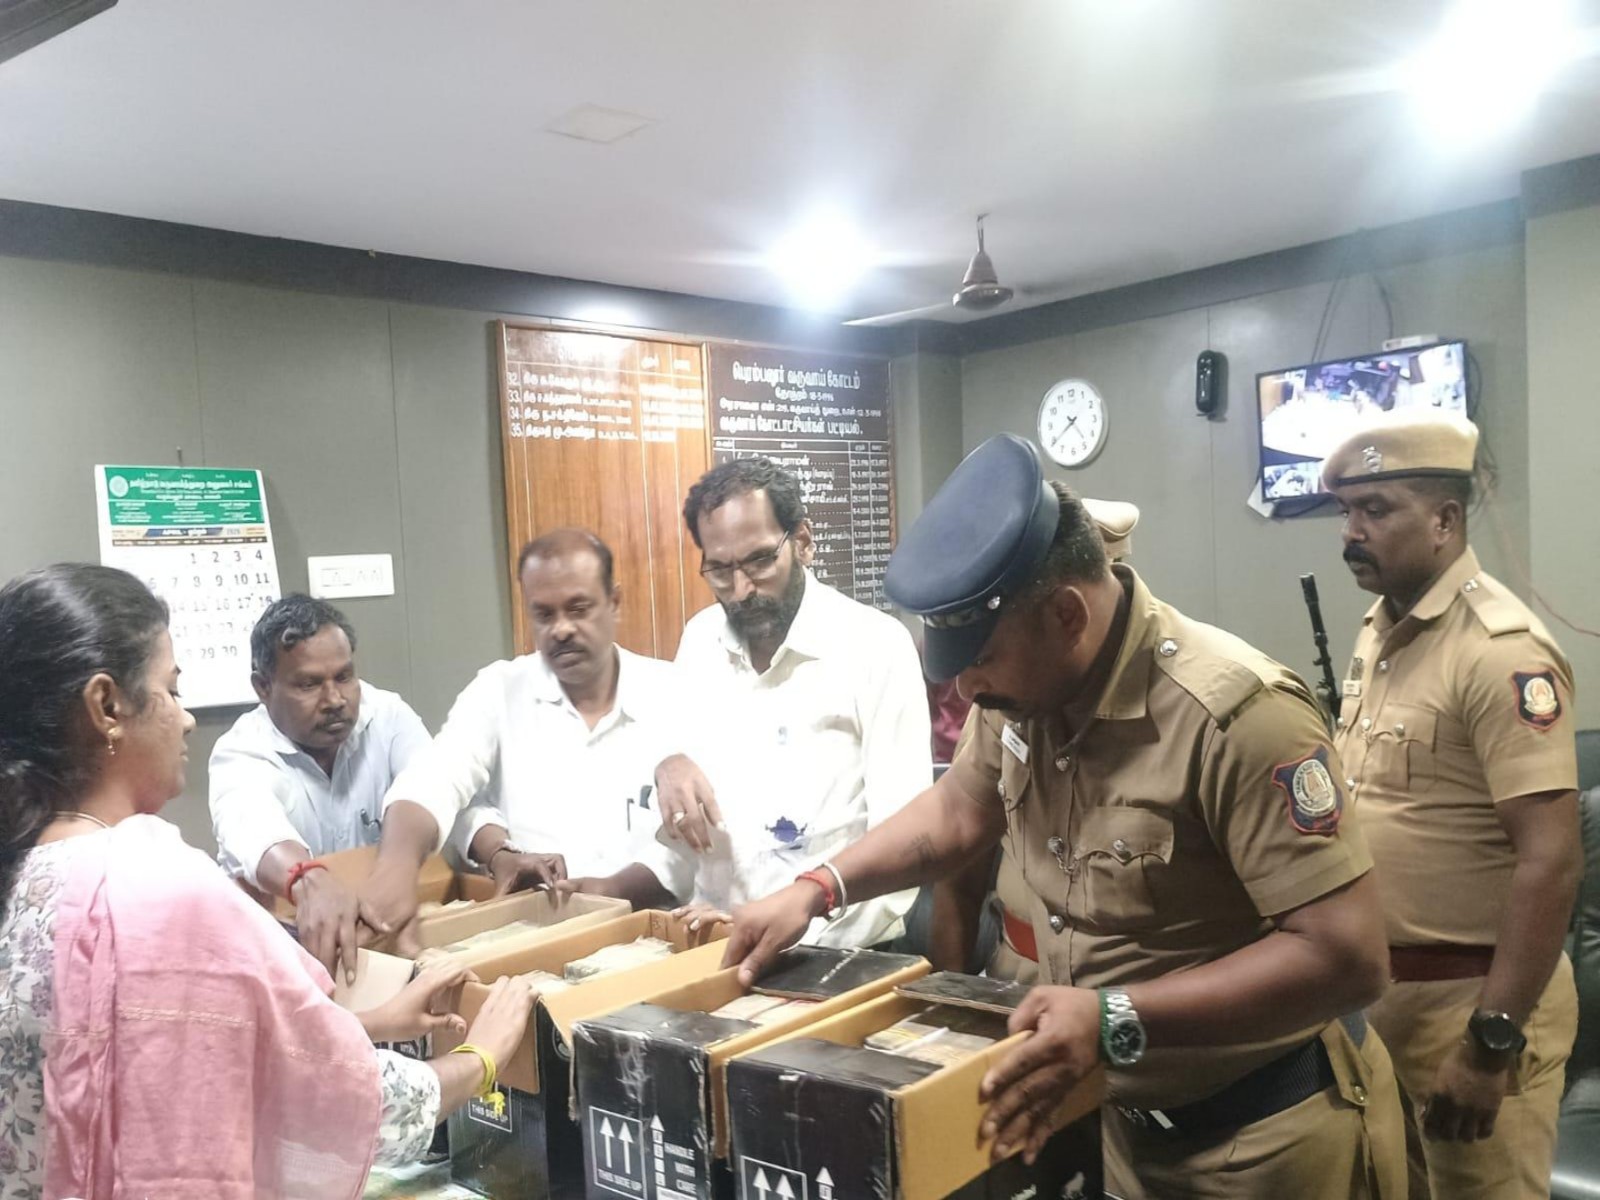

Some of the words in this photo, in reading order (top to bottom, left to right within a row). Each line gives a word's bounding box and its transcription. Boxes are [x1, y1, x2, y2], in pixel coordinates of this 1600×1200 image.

[827, 369, 861, 390] கோட்டம்
[213, 550, 220, 562] 2
[234, 550, 242, 562] 3
[255, 549, 263, 560] 4
[215, 575, 223, 586] 9
[234, 573, 248, 585] 10
[256, 572, 270, 584] 11
[598, 1168, 614, 1182] THIS
[613, 1174, 631, 1189] SIDE
